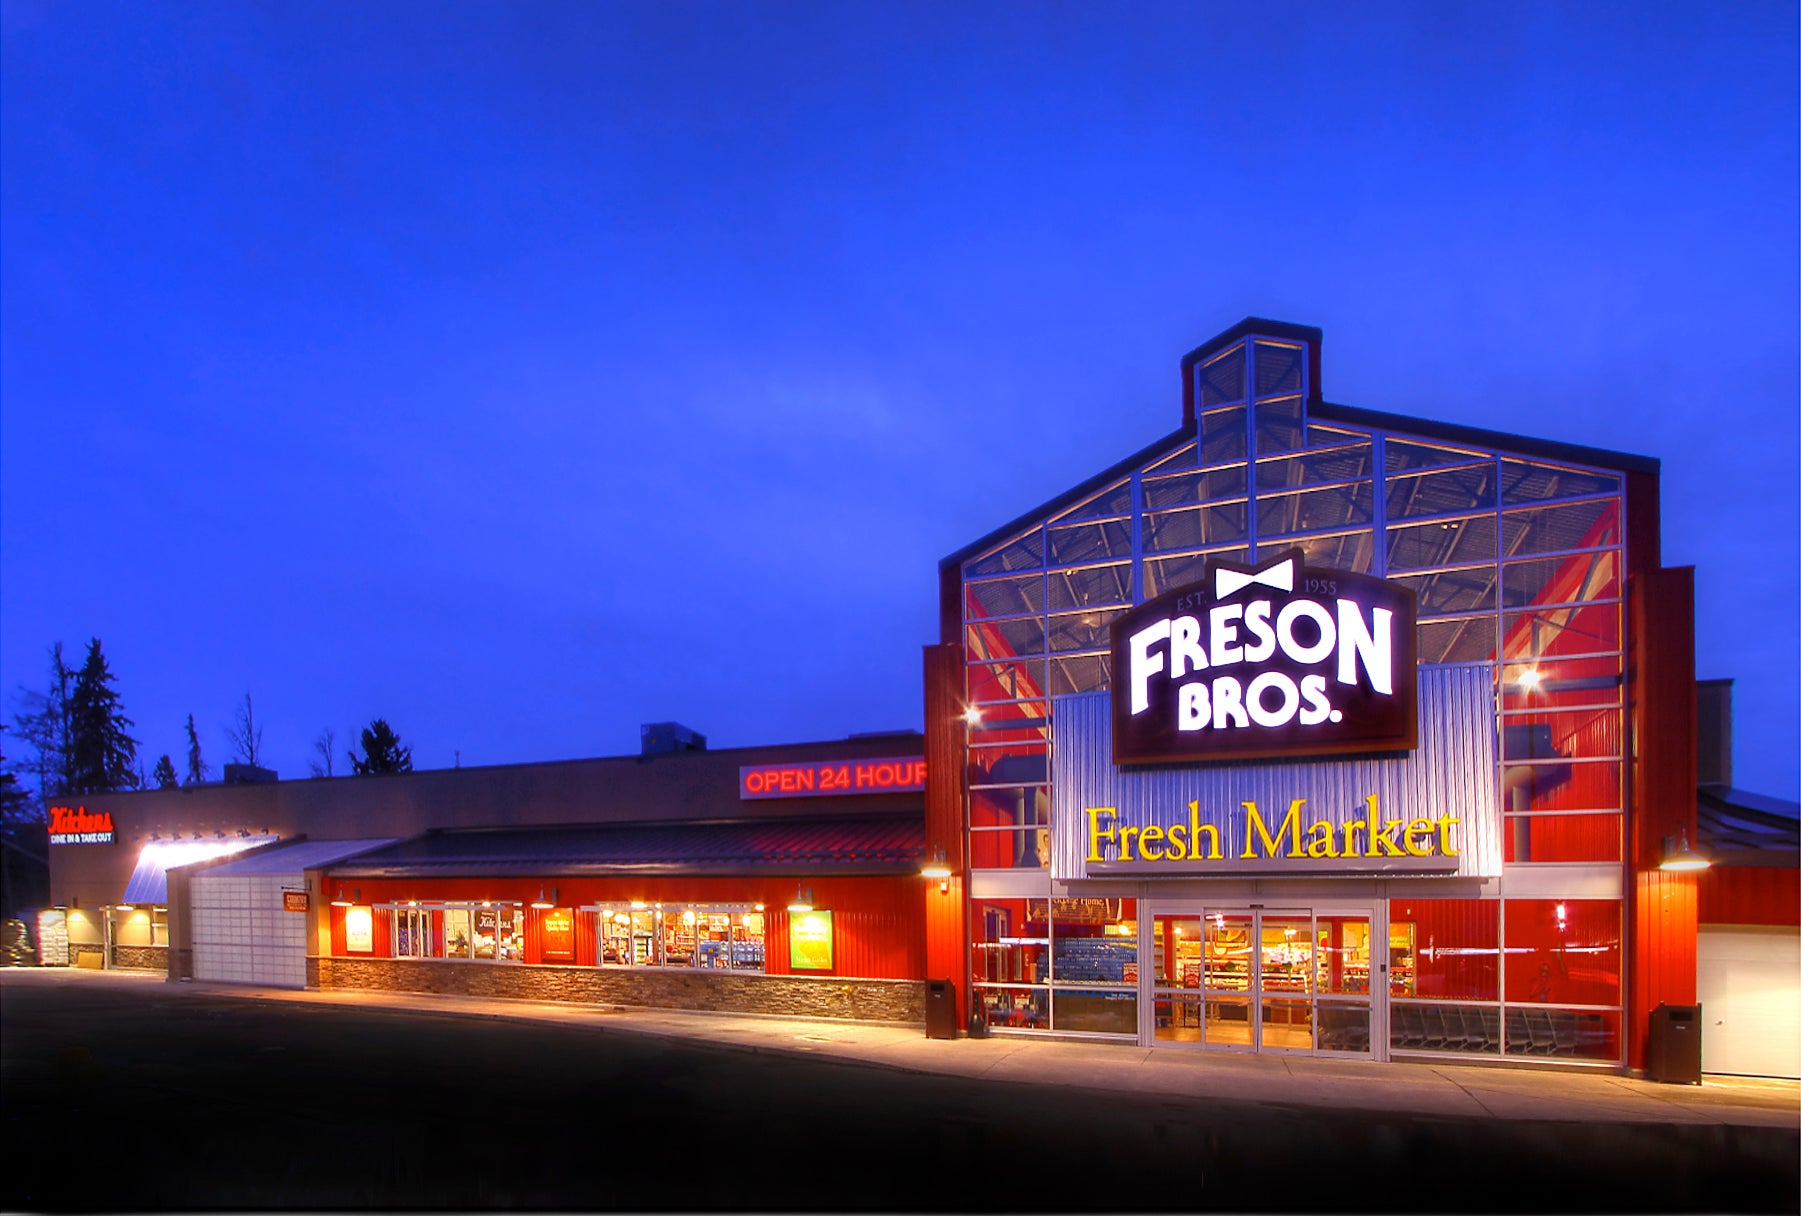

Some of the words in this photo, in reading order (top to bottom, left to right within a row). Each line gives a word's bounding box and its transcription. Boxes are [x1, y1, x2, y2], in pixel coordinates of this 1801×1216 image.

[1177, 591, 1207, 612] EST.
[1304, 578, 1337, 596] 1955
[1129, 598, 1393, 716] FRESON
[1178, 671, 1343, 731] BROS.
[745, 769, 815, 793] OPEN
[818, 765, 850, 791] 24
[48, 806, 113, 833] Kitchens
[1085, 800, 1223, 862] Fresh
[1239, 793, 1461, 859] Market
[50, 834, 66, 844] DINE
[67, 833, 75, 843] IN
[81, 833, 97, 843] TAKE
[97, 832, 112, 842] OUT
